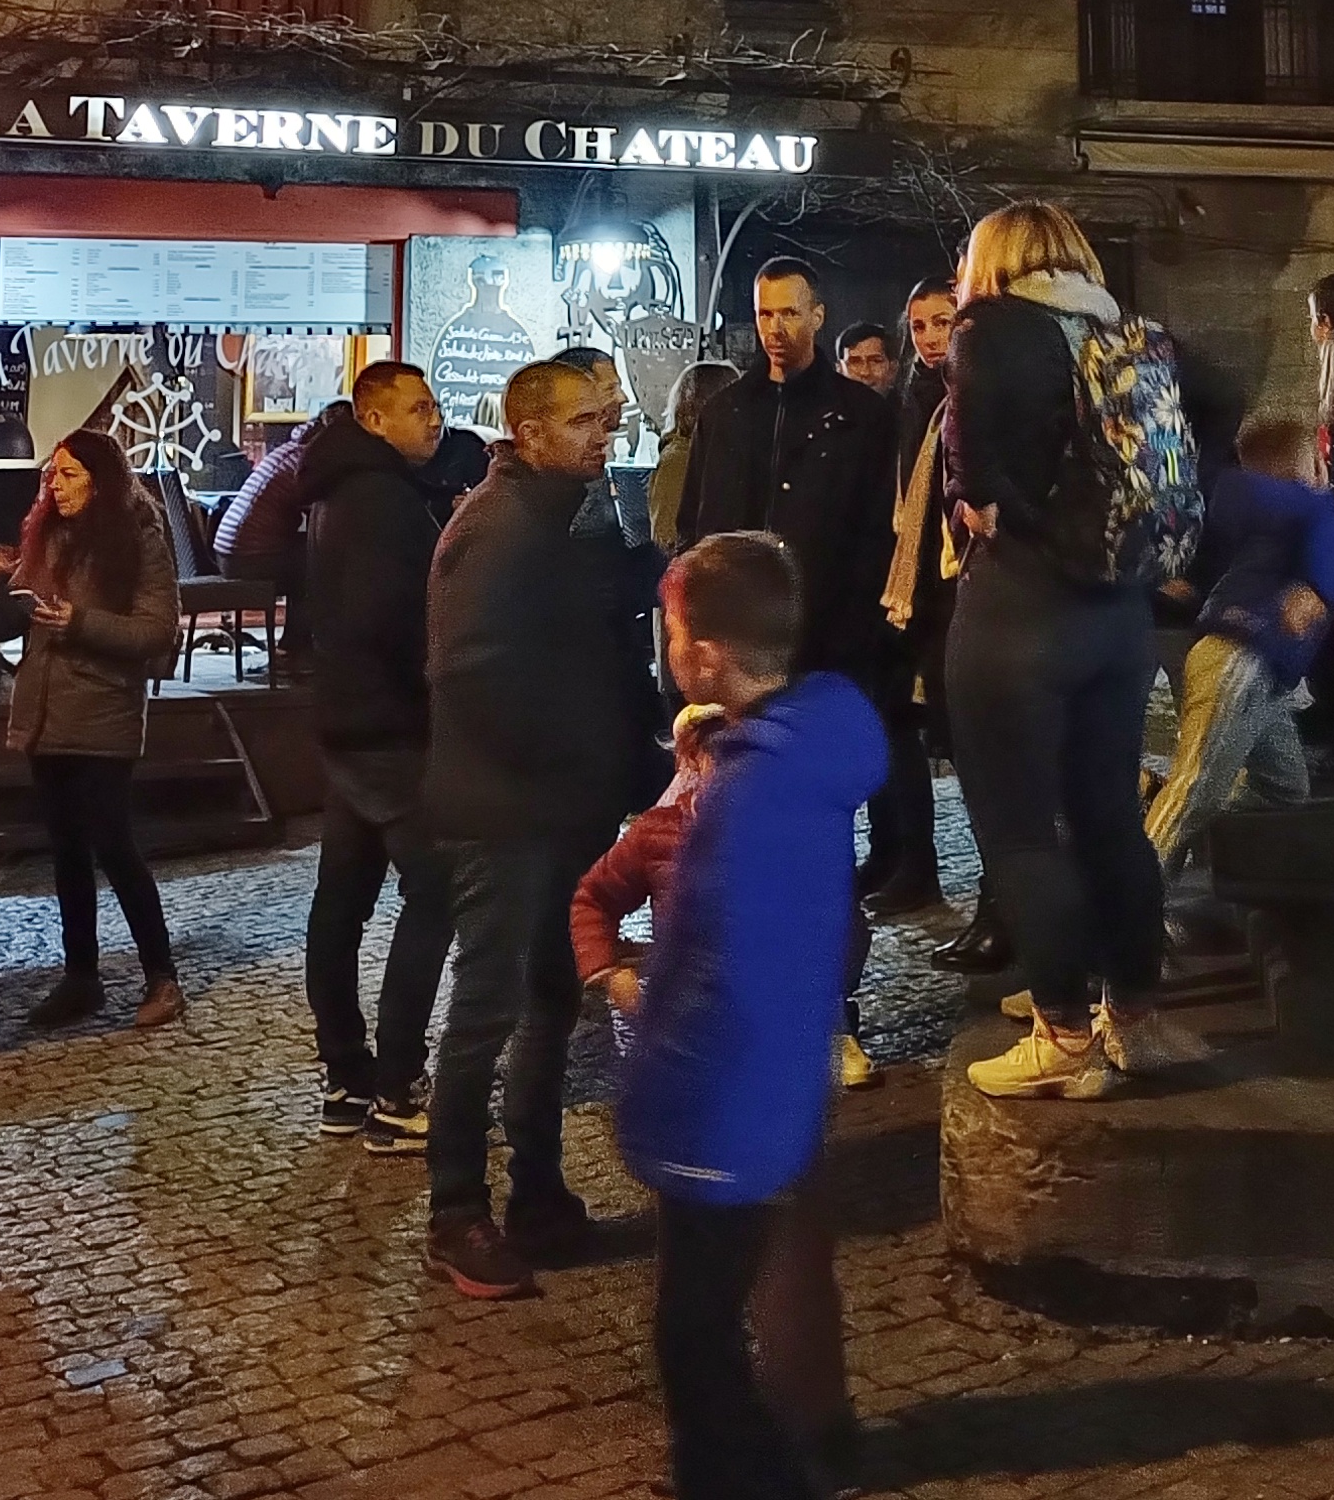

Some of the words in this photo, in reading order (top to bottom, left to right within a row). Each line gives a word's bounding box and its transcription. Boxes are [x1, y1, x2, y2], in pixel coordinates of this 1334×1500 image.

[69, 95, 398, 156] TAVERNE
[419, 120, 505, 158] DU
[524, 120, 818, 175] CHATEAU
[10, 322, 154, 380] Taverne
